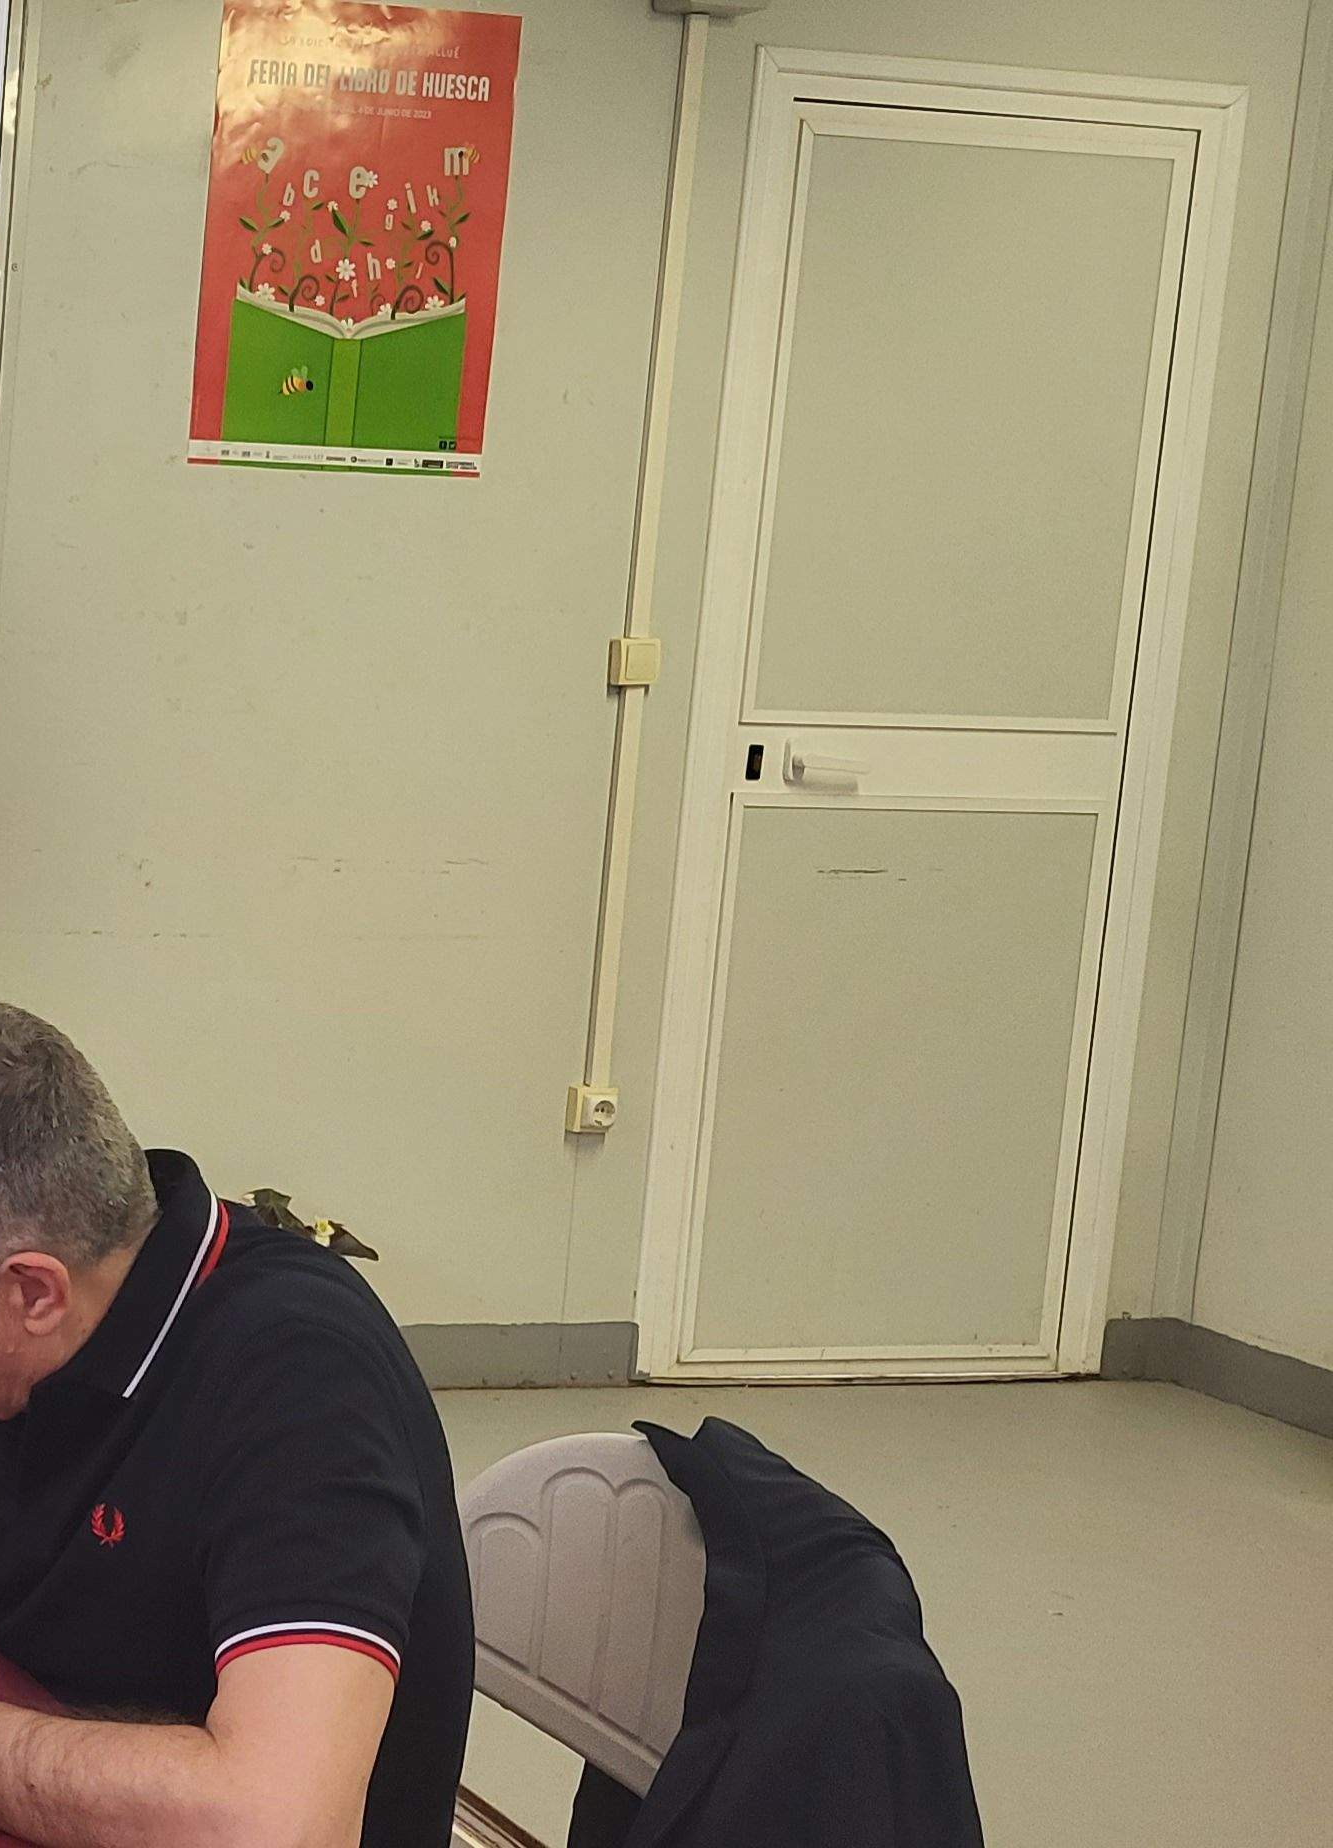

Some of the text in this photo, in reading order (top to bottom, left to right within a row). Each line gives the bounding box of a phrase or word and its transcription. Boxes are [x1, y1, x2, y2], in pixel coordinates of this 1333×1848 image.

[247, 58, 298, 87] FERIA
[338, 66, 390, 94] LIBRO
[395, 70, 418, 97] DE
[421, 72, 490, 102] HUESCA
[303, 169, 319, 199] c
[348, 165, 369, 199] e
